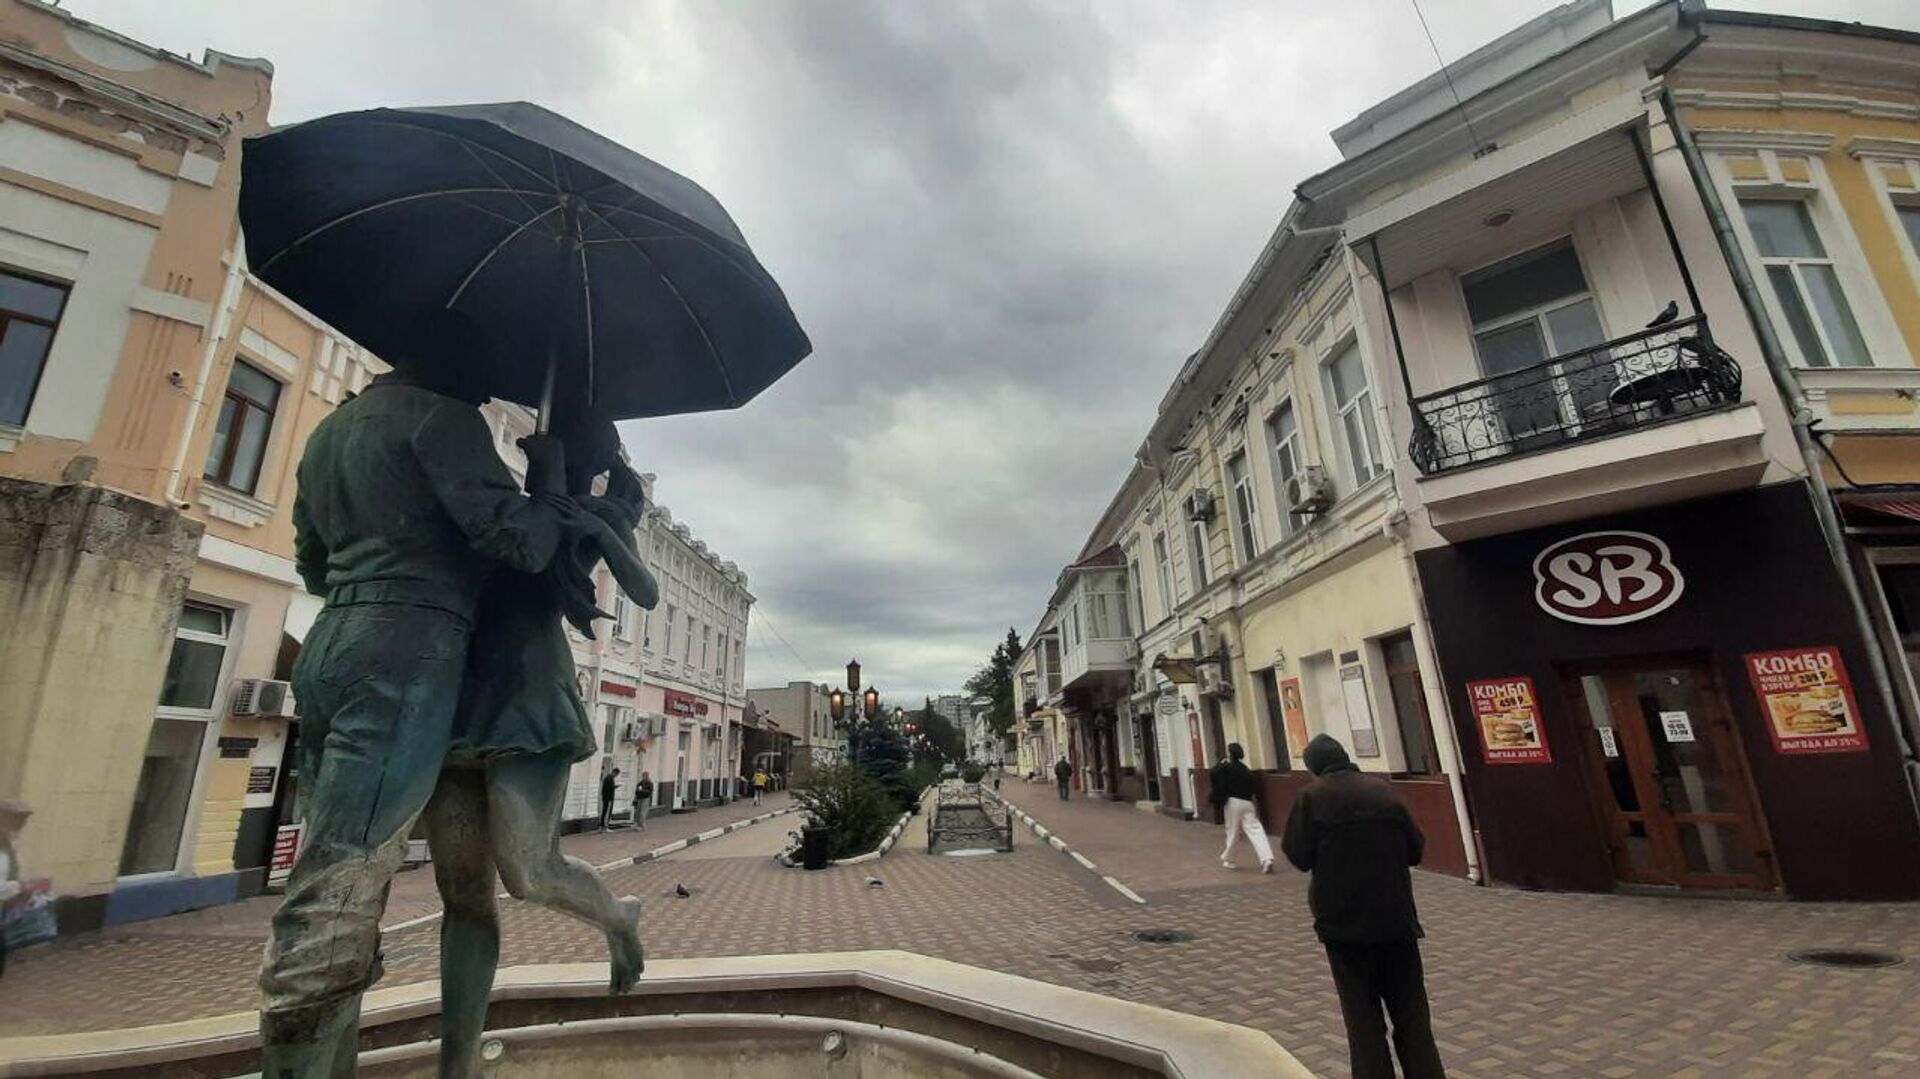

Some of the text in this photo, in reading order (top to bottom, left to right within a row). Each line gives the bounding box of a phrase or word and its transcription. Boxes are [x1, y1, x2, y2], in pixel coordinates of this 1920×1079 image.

[1549, 545, 1663, 608] SB
[1754, 652, 1834, 674] КОМБО
[1474, 682, 1528, 699] КОМБО
[1780, 739, 1822, 750] ВЫГОДА
[1823, 738, 1838, 748] ДО
